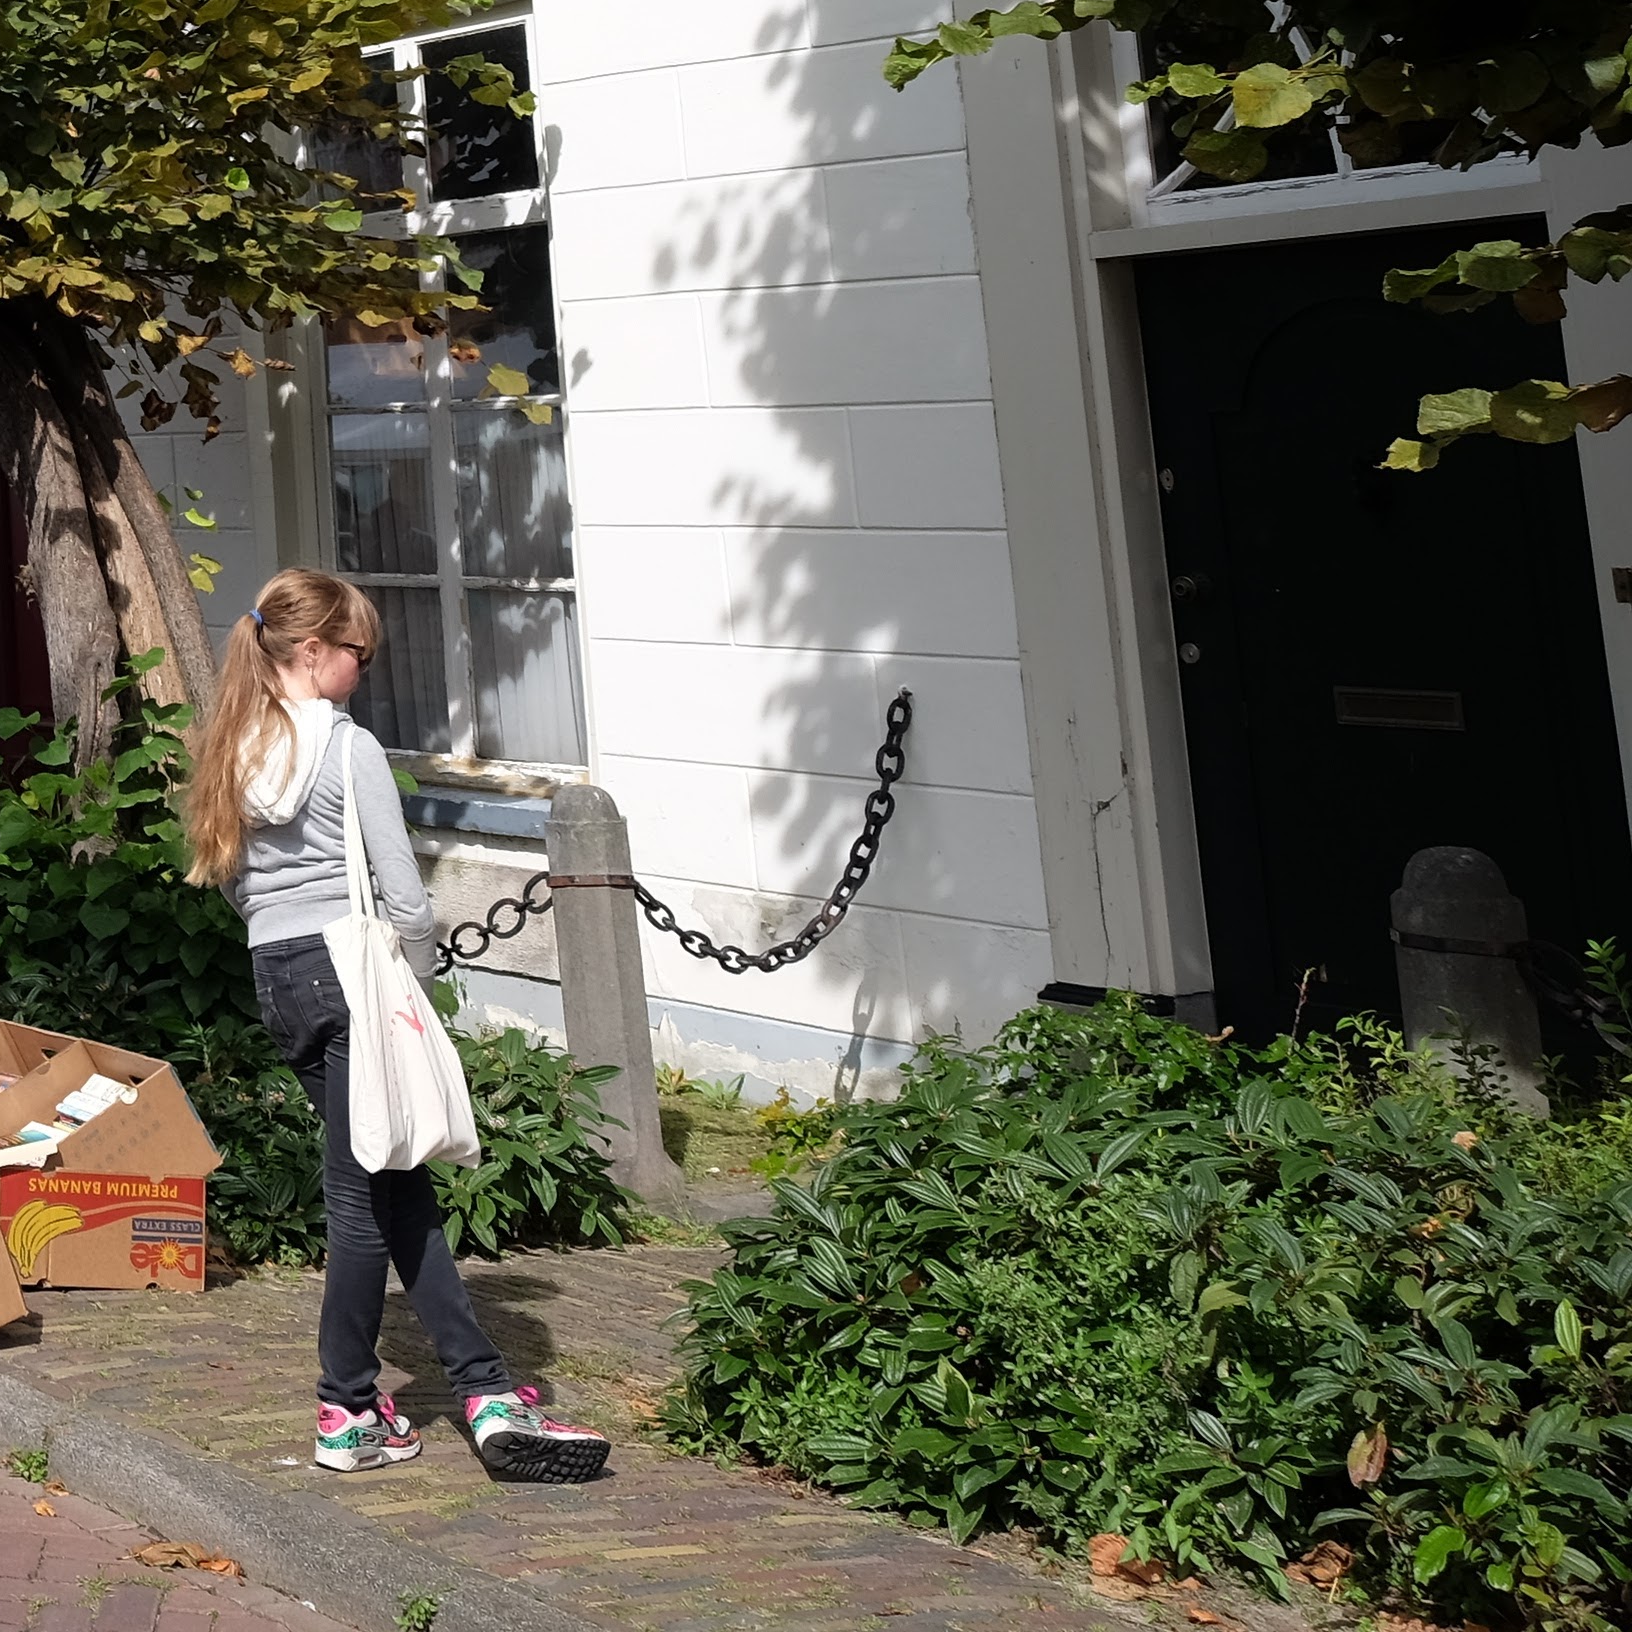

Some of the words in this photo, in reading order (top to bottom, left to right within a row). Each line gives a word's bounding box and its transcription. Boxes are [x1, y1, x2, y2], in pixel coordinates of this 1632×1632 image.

[28, 1178, 102, 1195] BANANAS
[106, 1182, 178, 1199] PREMIUM
[133, 1219, 167, 1231] EXTRA
[171, 1220, 202, 1232] CLASS
[130, 1242, 203, 1279] Dole
